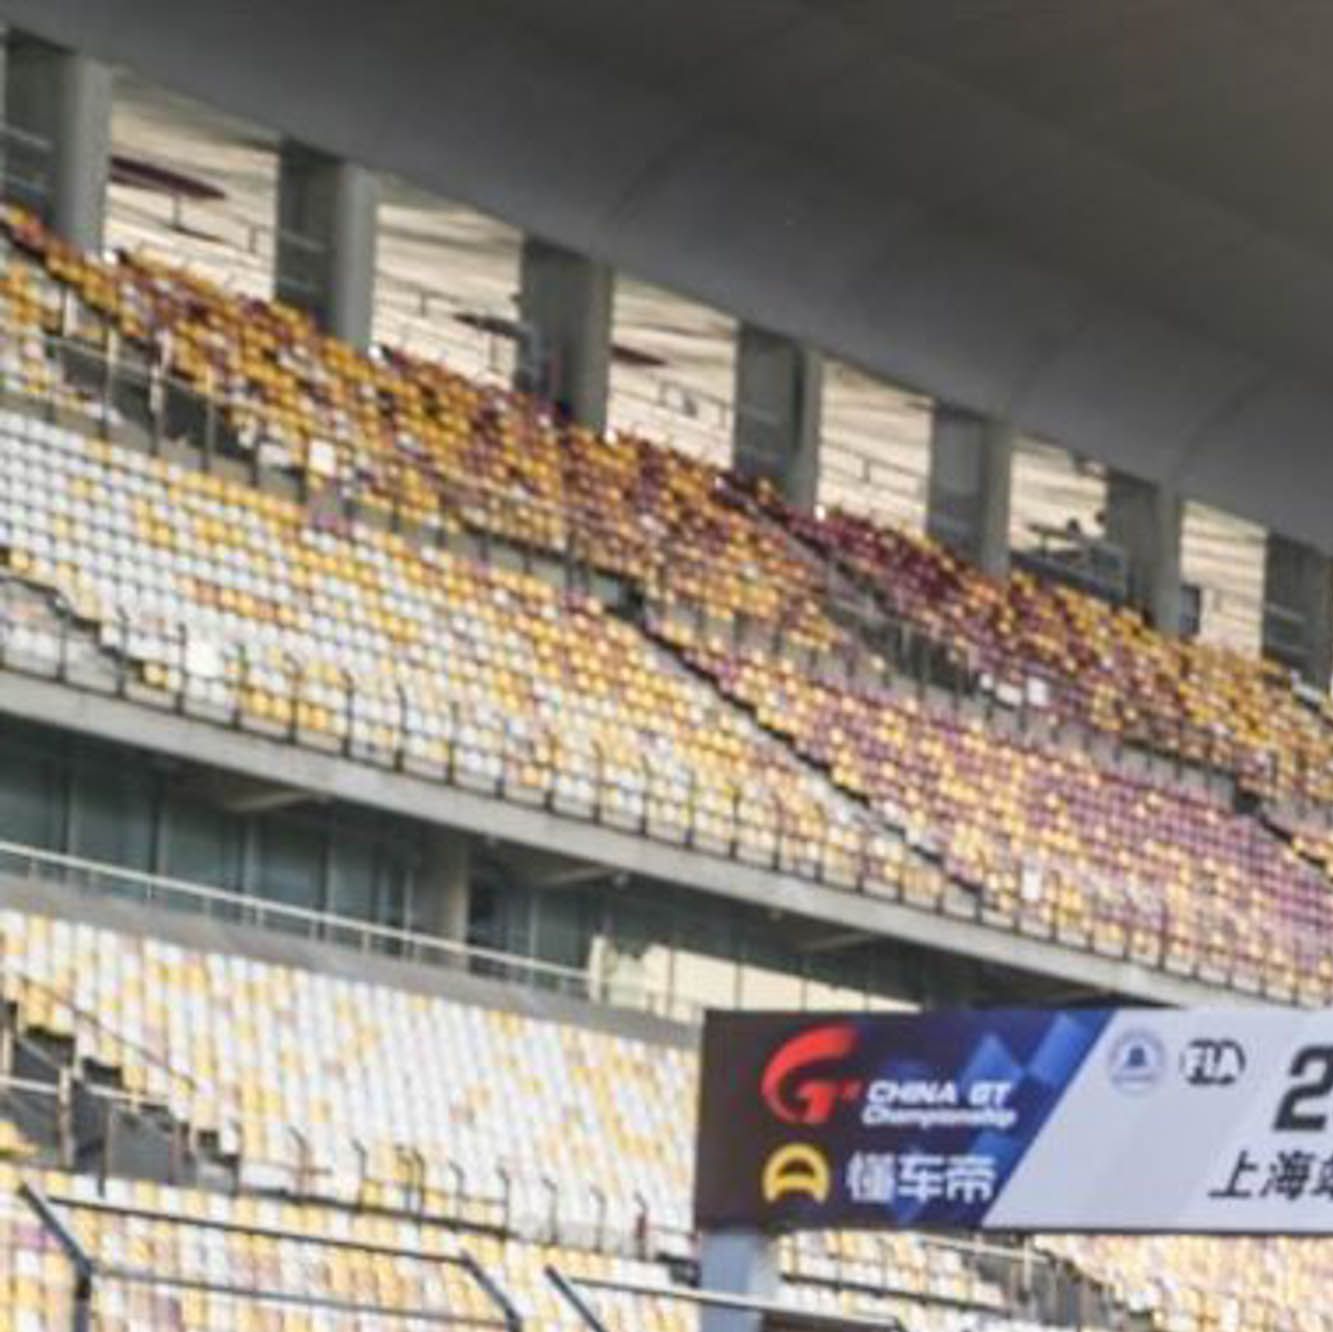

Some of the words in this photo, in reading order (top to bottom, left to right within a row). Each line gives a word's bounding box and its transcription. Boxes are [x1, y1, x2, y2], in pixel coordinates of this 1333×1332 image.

[1179, 1039, 1246, 1086] FIA
[866, 1080, 957, 1105] CHINA
[968, 1080, 1014, 1104] GT
[845, 1149, 998, 1204] 懂车帝
